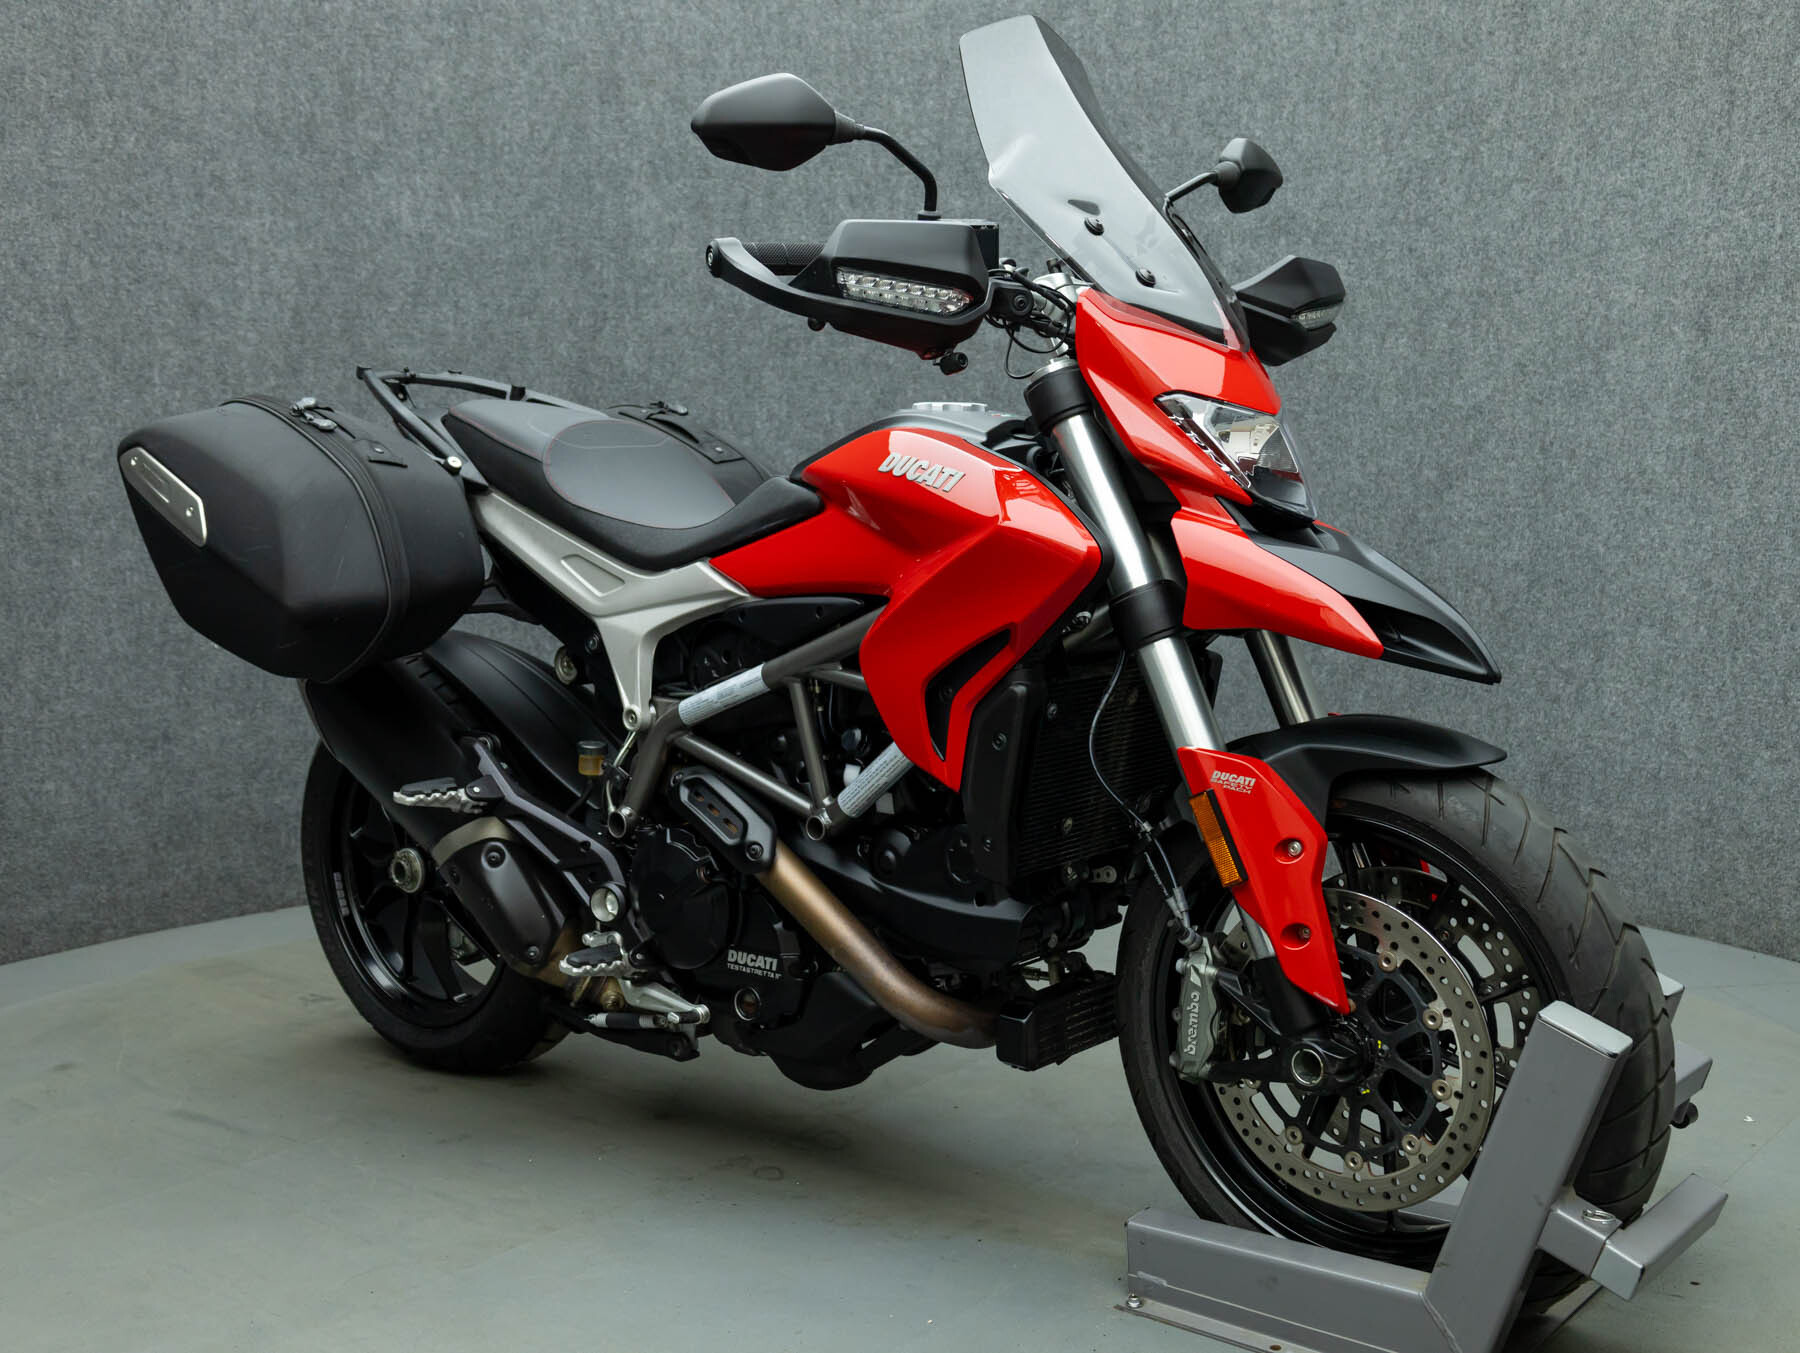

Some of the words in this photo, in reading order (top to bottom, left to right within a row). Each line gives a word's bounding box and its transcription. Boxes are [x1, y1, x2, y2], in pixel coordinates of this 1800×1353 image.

[878, 452, 966, 493] DUCATI
[1211, 770, 1256, 786] DUCATI
[727, 949, 778, 971] DUCATI
[1184, 991, 1200, 1056] brembo
